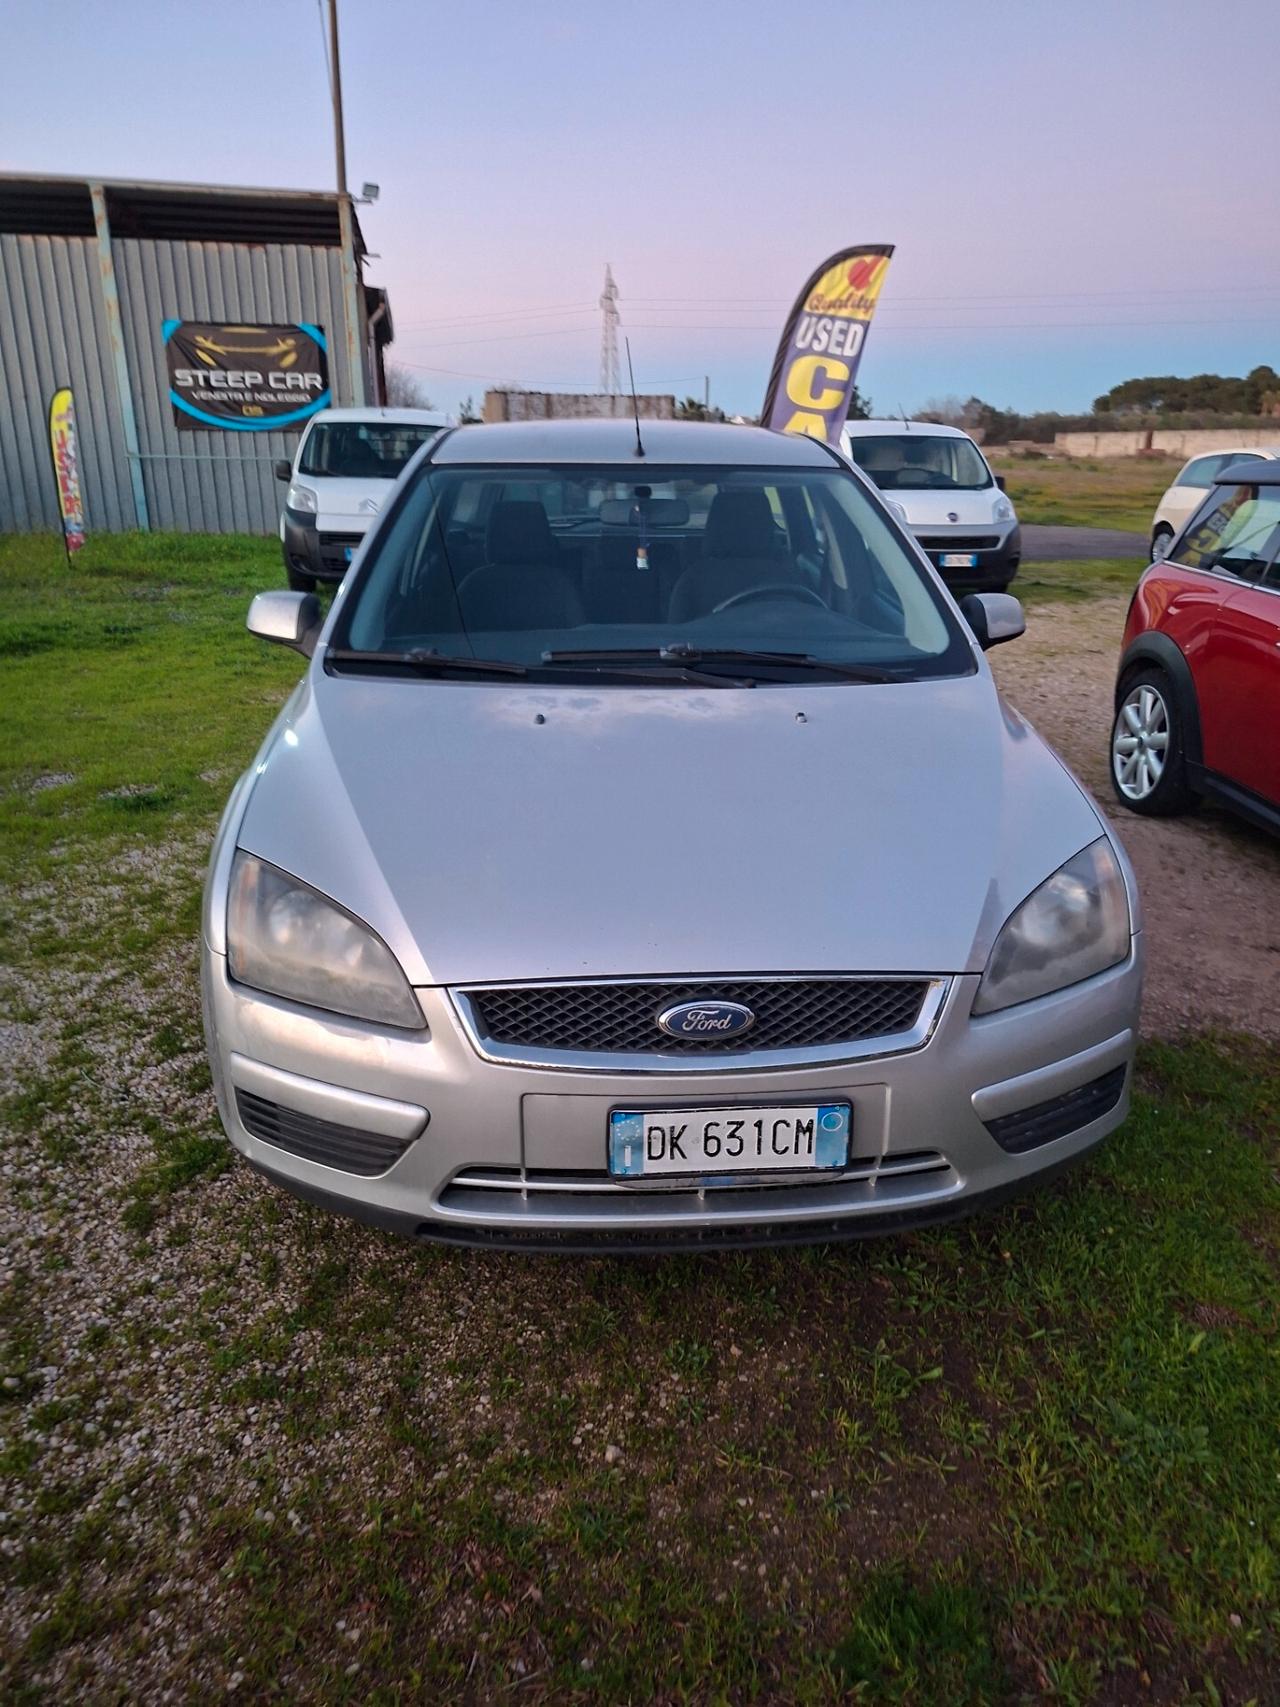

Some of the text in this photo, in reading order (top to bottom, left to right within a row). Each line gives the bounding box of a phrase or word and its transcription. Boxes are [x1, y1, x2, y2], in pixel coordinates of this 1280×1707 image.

[795, 316, 864, 357] USED
[174, 368, 323, 391] STEEP CAR
[682, 1009, 731, 1031] Ford
[647, 1124, 688, 1161] DK
[702, 1118, 815, 1157] 631CM
